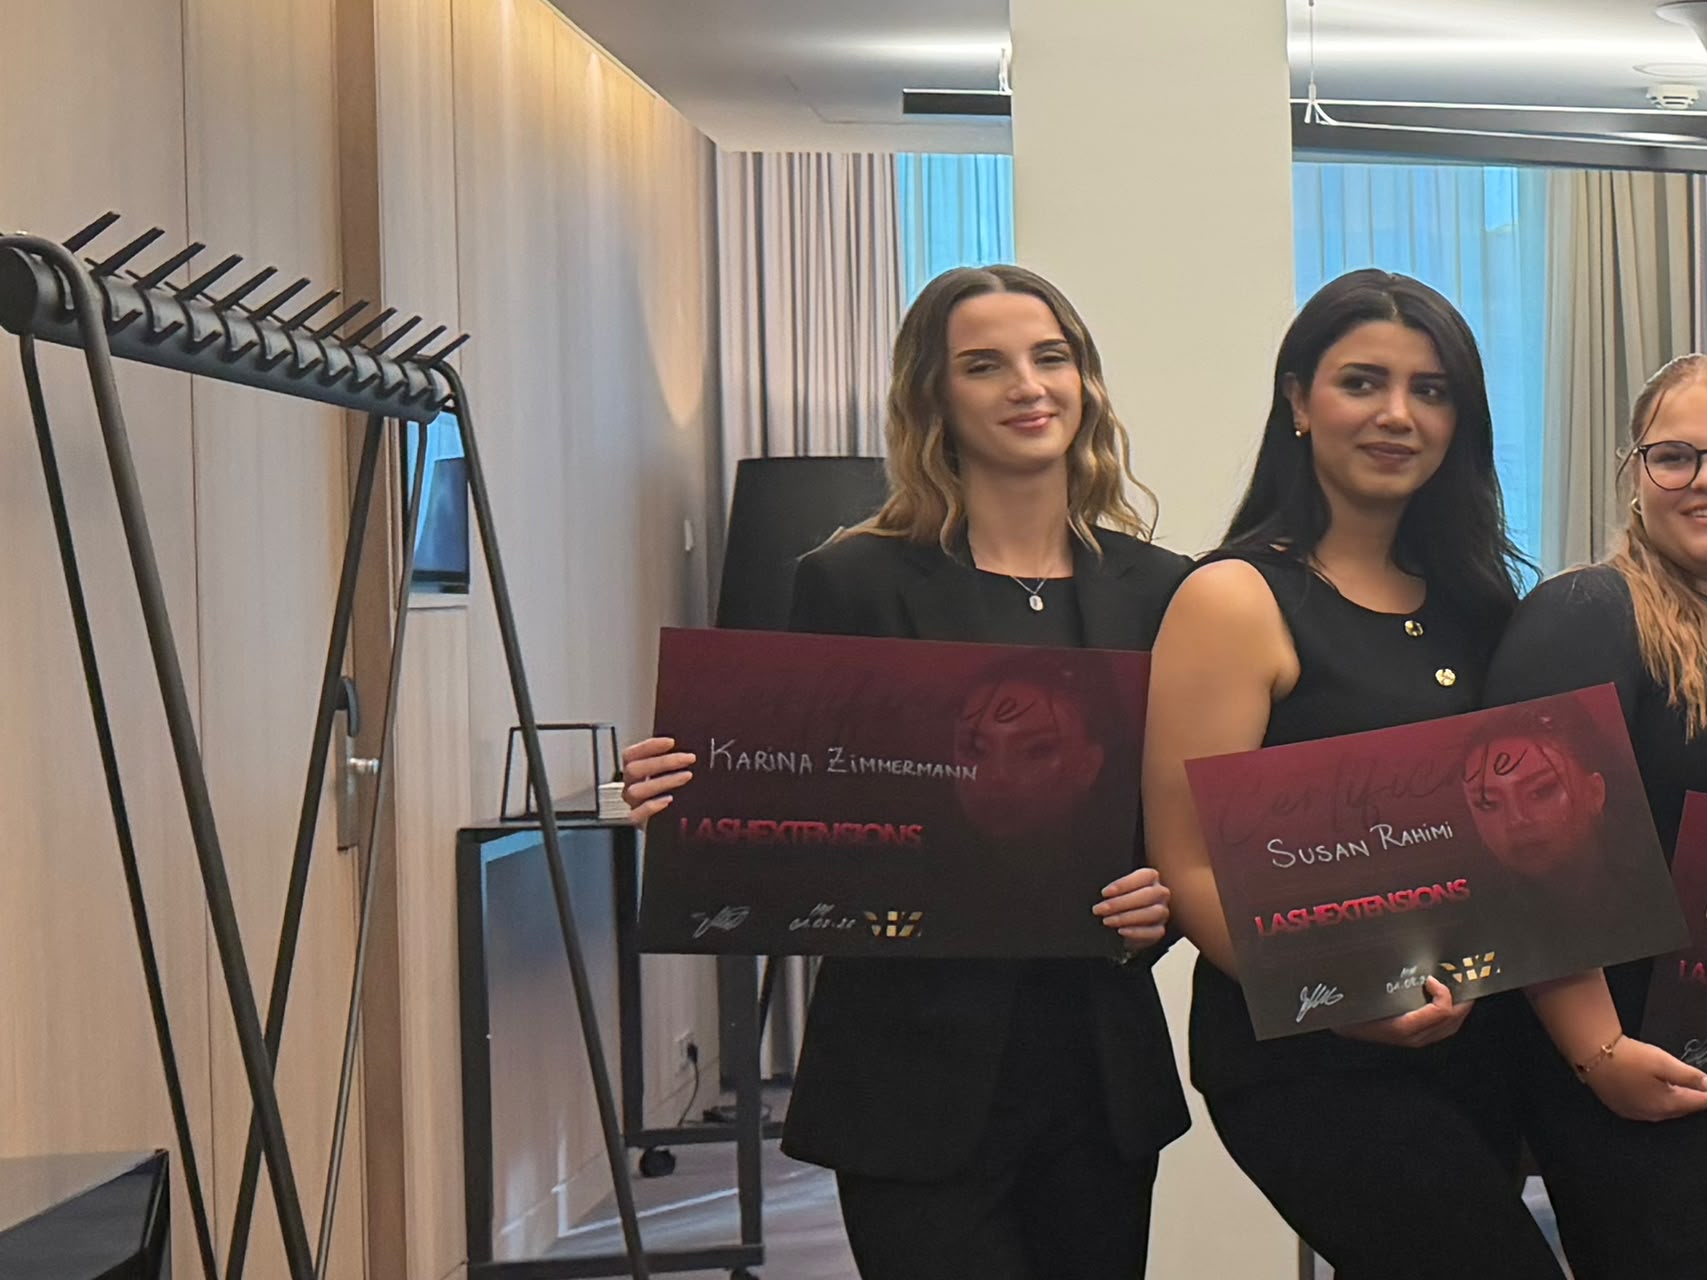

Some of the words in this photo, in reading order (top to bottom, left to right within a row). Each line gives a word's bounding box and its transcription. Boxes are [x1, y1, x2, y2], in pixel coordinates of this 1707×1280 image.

[679, 817, 925, 847] LASHEXTENSIONS
[1267, 838, 1370, 868] SUSAN
[1255, 878, 1472, 937] LASHEXTENSIONS
